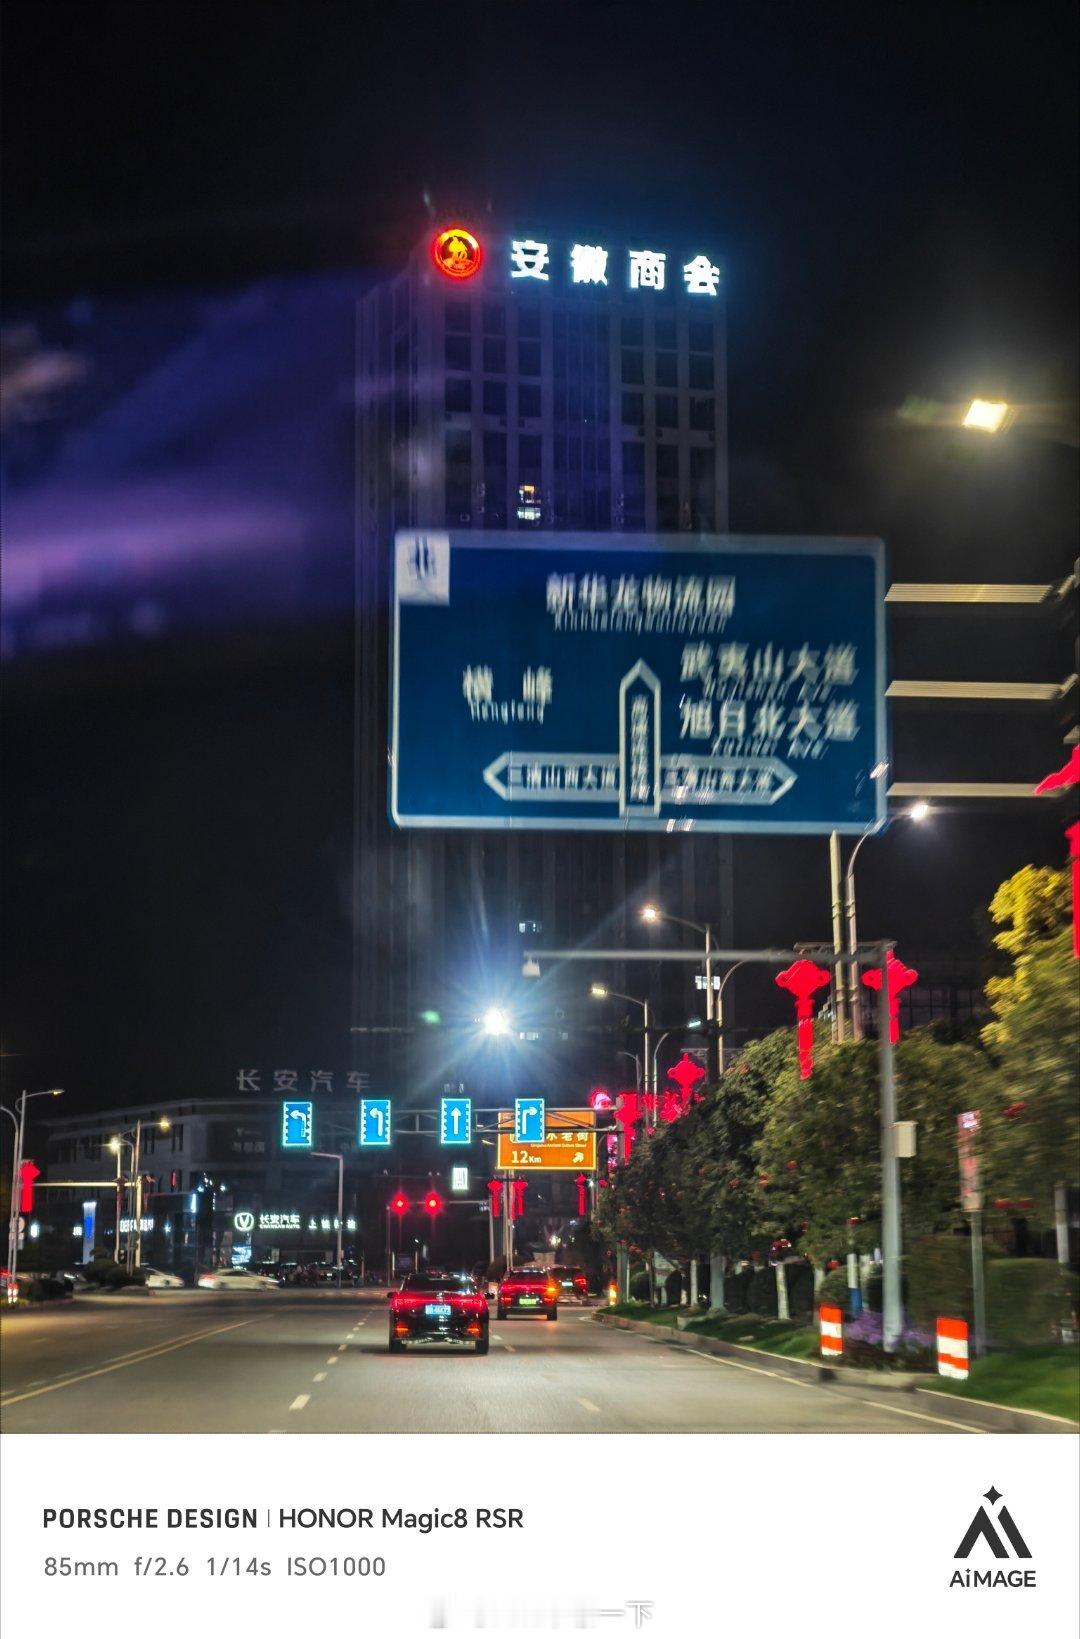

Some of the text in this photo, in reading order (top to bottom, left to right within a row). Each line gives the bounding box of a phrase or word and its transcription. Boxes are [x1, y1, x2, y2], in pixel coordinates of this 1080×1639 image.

[510, 239, 720, 296] 安徽商会
[680, 641, 859, 686] 武夷山大道
[680, 698, 860, 741] 旭日北大道
[235, 1068, 371, 1093] 长安汽车
[259, 1213, 300, 1224] 长安汽车
